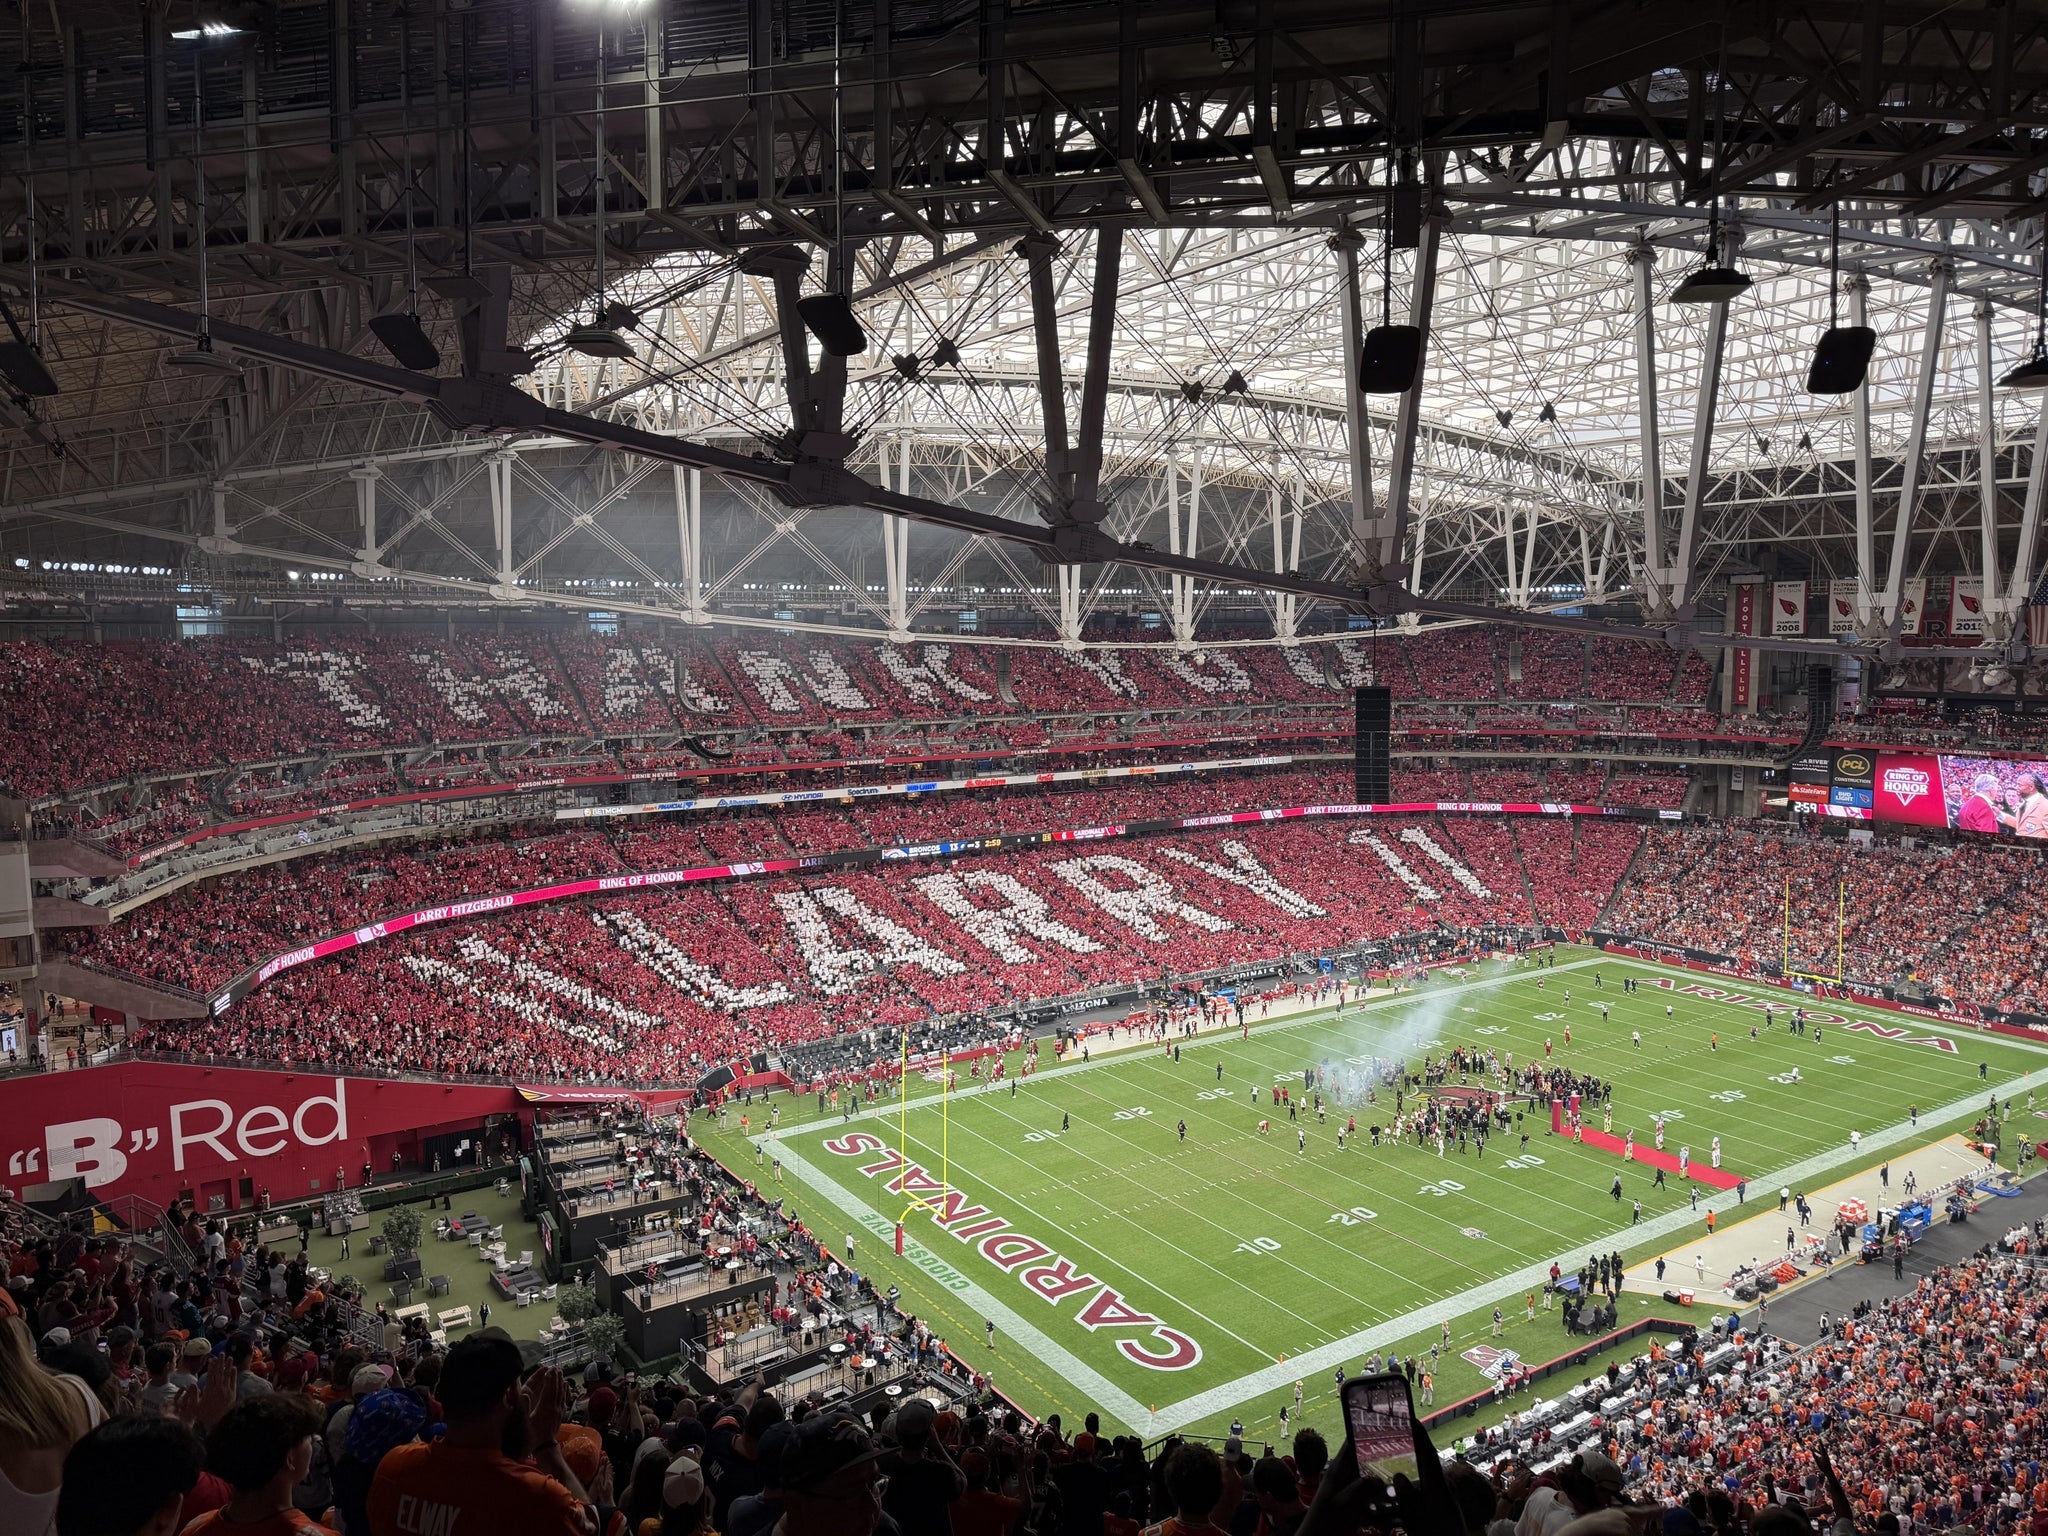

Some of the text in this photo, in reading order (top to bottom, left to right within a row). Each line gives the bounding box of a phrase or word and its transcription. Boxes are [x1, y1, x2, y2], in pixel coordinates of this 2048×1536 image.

[1776, 624, 1800, 632] 2008
[1832, 624, 1853, 632] 2008
[1902, 623, 1914, 631] 09
[1253, 757, 1278, 765] AVNET
[1841, 759, 1865, 770] PCL
[1834, 776, 1871, 784] CONSTRUCTION
[1889, 772, 1910, 780] RING
[517, 780, 541, 788] CARSON
[542, 778, 565, 786] PALMER
[1884, 781, 1929, 794] HONOR
[793, 792, 824, 800] HYUNDAI
[847, 787, 879, 796] Spectrum
[1304, 803, 1373, 815] LARRY FITZGERALD
[1437, 803, 1458, 811] RING
[1472, 803, 1503, 811] HONOR
[1794, 801, 1817, 813] 2:59
[1182, 814, 1233, 827] RING OF HONOR
[1061, 831, 1067, 840] 6
[1073, 827, 1105, 837] CARDINALS
[909, 844, 941, 854] BRONCOS
[984, 839, 1002, 848] 2:59
[599, 870, 685, 890] RING OF HONOR
[413, 895, 515, 925] LARRY FITZGERALD
[592, 836, 1328, 1012] LARRY
[258, 946, 315, 983] RING OF HONOR
[1707, 966, 1739, 977] ARIZONA
[1636, 976, 1961, 1055] ARIZONA
[1901, 1005, 1939, 1018] ARIZONA
[557, 1091, 630, 1100] verizon
[169, 1078, 348, 1172] Red
[1031, 1128, 1061, 1142] 10
[1506, 1153, 1546, 1171] 40
[1421, 1178, 1467, 1198] 30
[1333, 1205, 1379, 1228] 20
[821, 1131, 1205, 1372] CARDINALS
[1243, 1236, 1282, 1257] 10
[902, 1242, 971, 1291] CHOOSE
[396, 1493, 463, 1536] ELWAY
